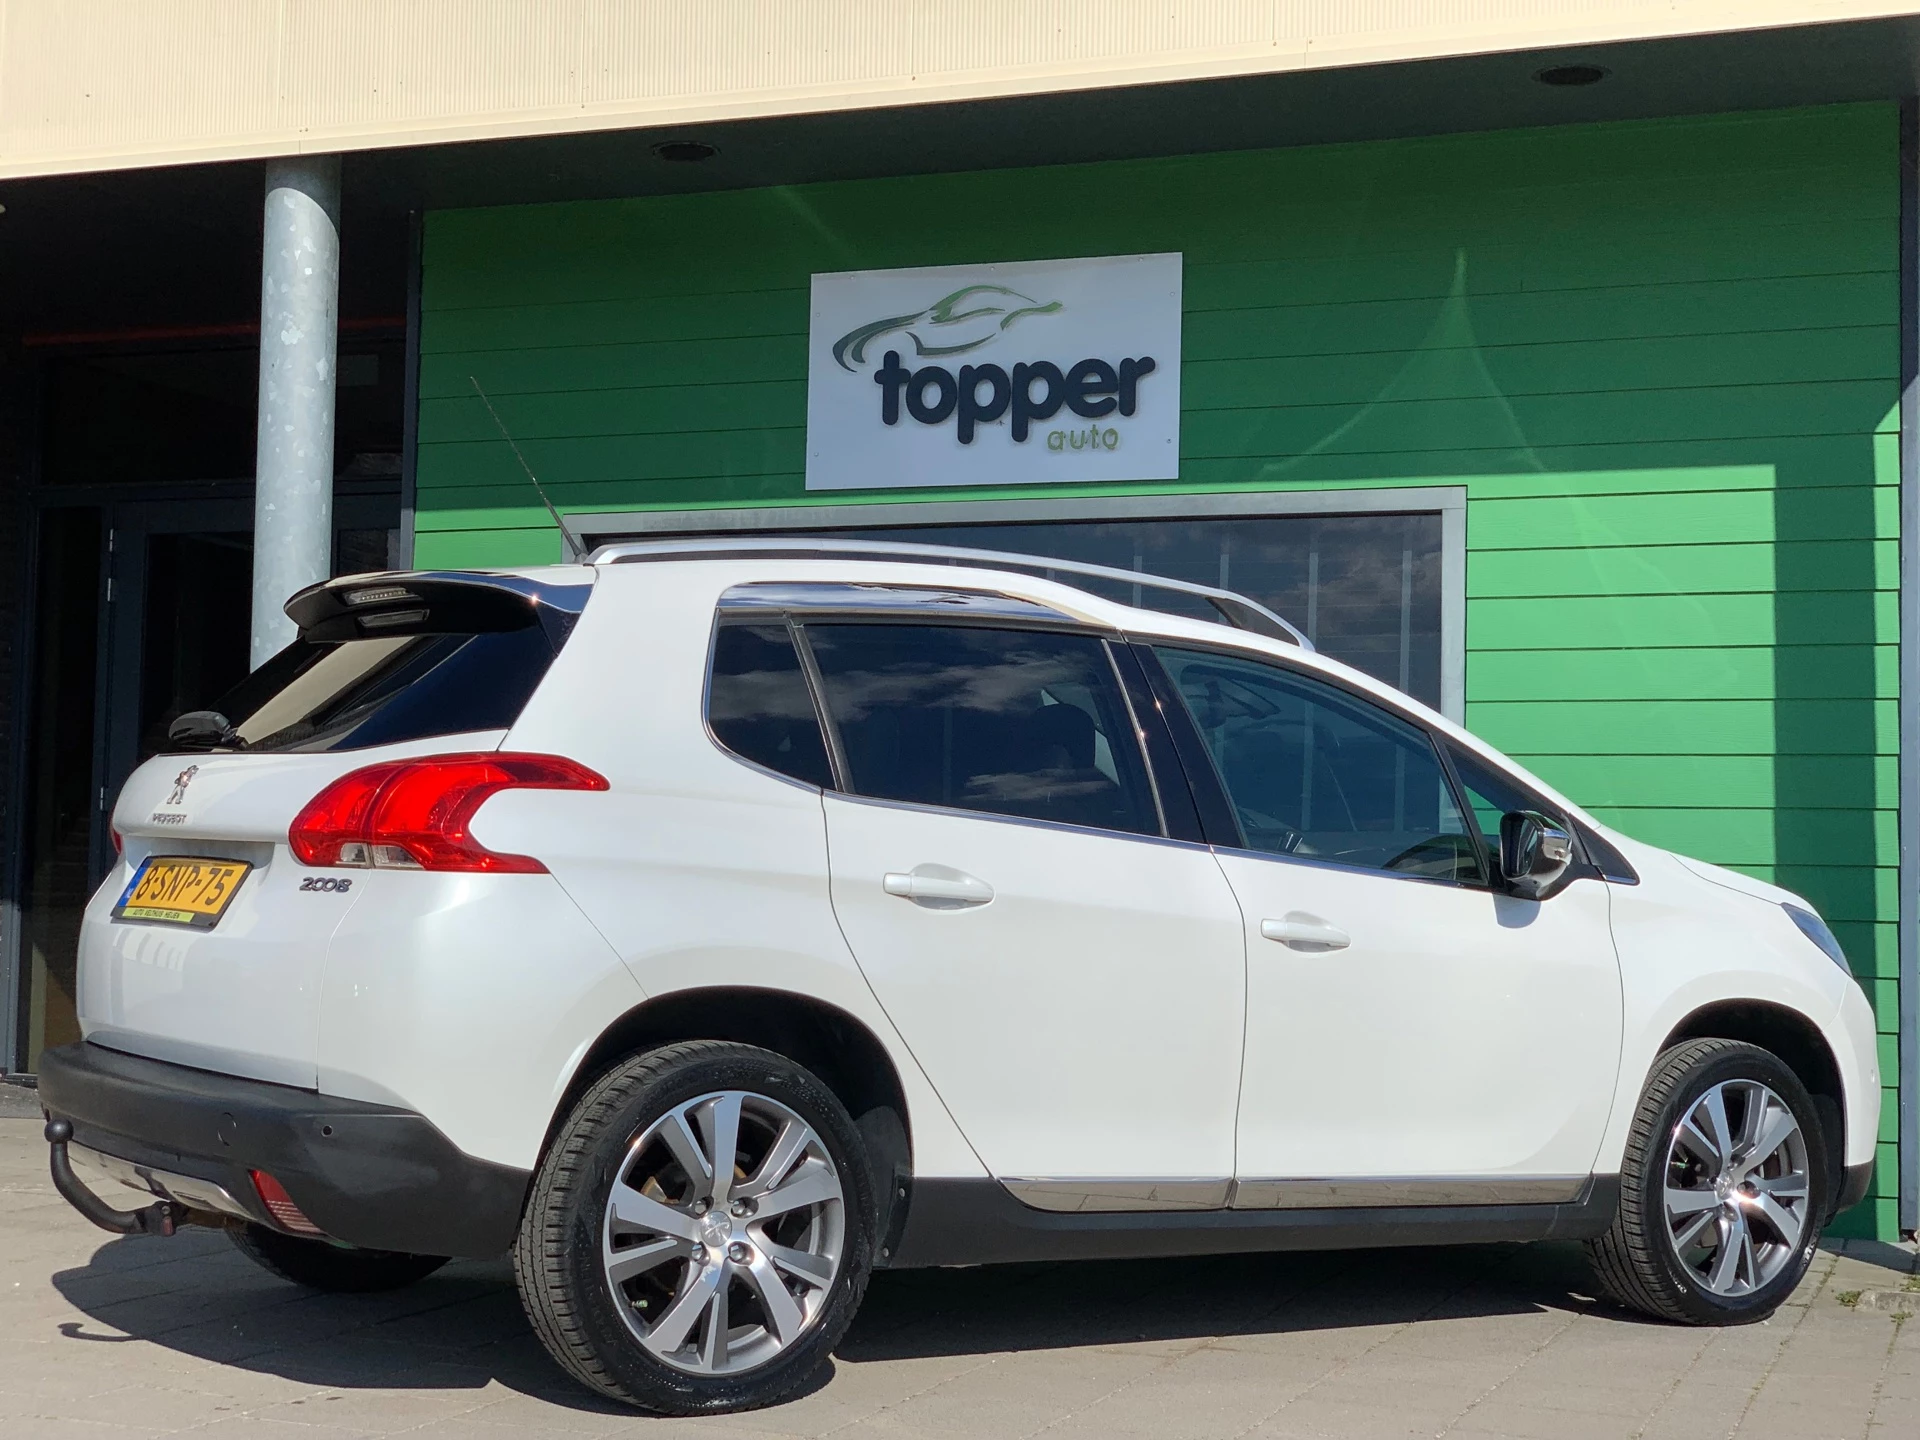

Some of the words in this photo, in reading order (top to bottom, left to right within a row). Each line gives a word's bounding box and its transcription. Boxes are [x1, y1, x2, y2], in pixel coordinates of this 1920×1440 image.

[874, 350, 1156, 444] topper
[1047, 424, 1119, 451] auto
[136, 864, 235, 906] 8-SNP-75
[299, 876, 353, 893] 2008
